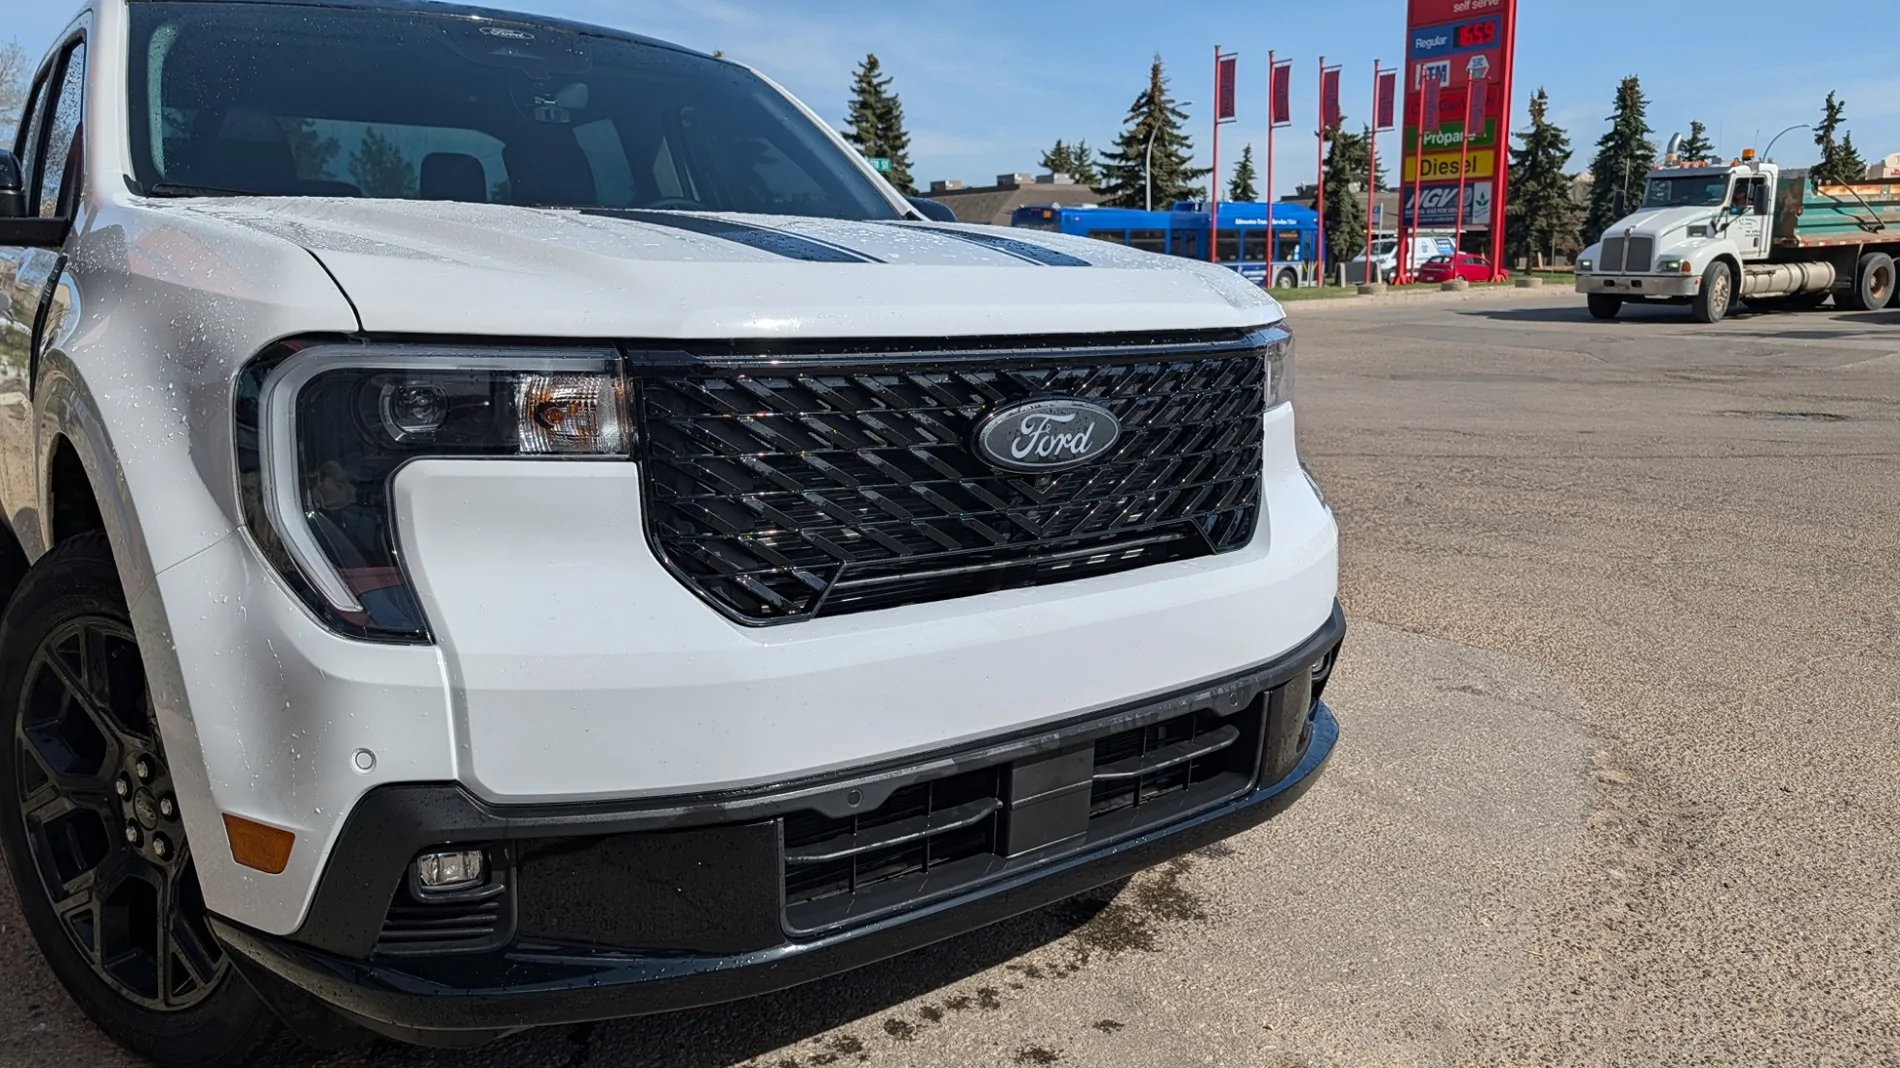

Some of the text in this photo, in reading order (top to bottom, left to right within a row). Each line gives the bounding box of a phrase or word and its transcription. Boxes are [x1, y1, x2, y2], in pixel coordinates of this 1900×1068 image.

[1415, 36, 1447, 49] Regular
[1420, 155, 1477, 176] Diesel
[1011, 413, 1095, 459] Ford
